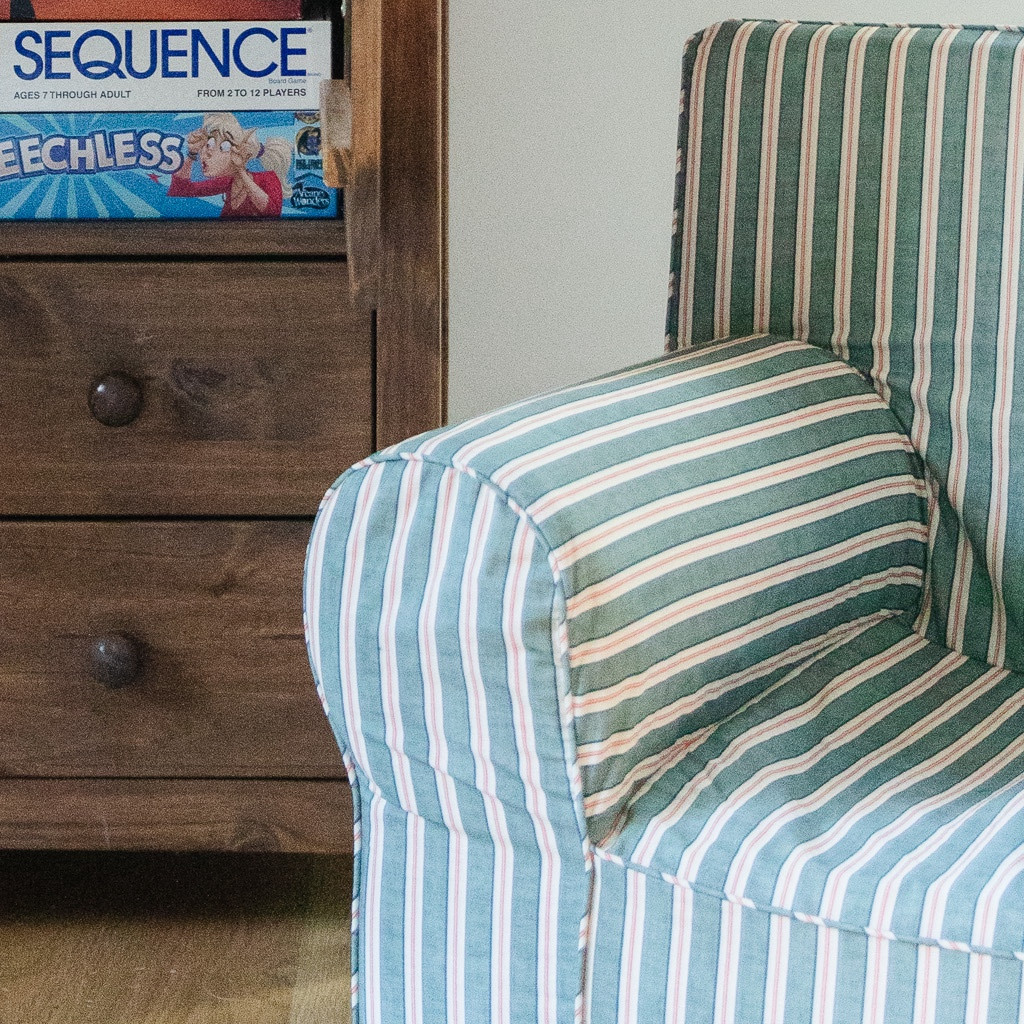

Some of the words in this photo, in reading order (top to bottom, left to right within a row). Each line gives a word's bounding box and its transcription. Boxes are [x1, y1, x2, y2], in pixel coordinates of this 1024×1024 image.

[13, 27, 307, 81] SEQUENCE
[14, 90, 41, 100] AGES
[42, 90, 48, 99] 7
[49, 90, 97, 100] THROUGH
[100, 89, 131, 99] ADULT
[197, 88, 224, 98] FROM
[226, 88, 234, 97] 2
[234, 88, 248, 97] TO
[250, 88, 261, 97] 12
[263, 88, 307, 97] PLAYERS
